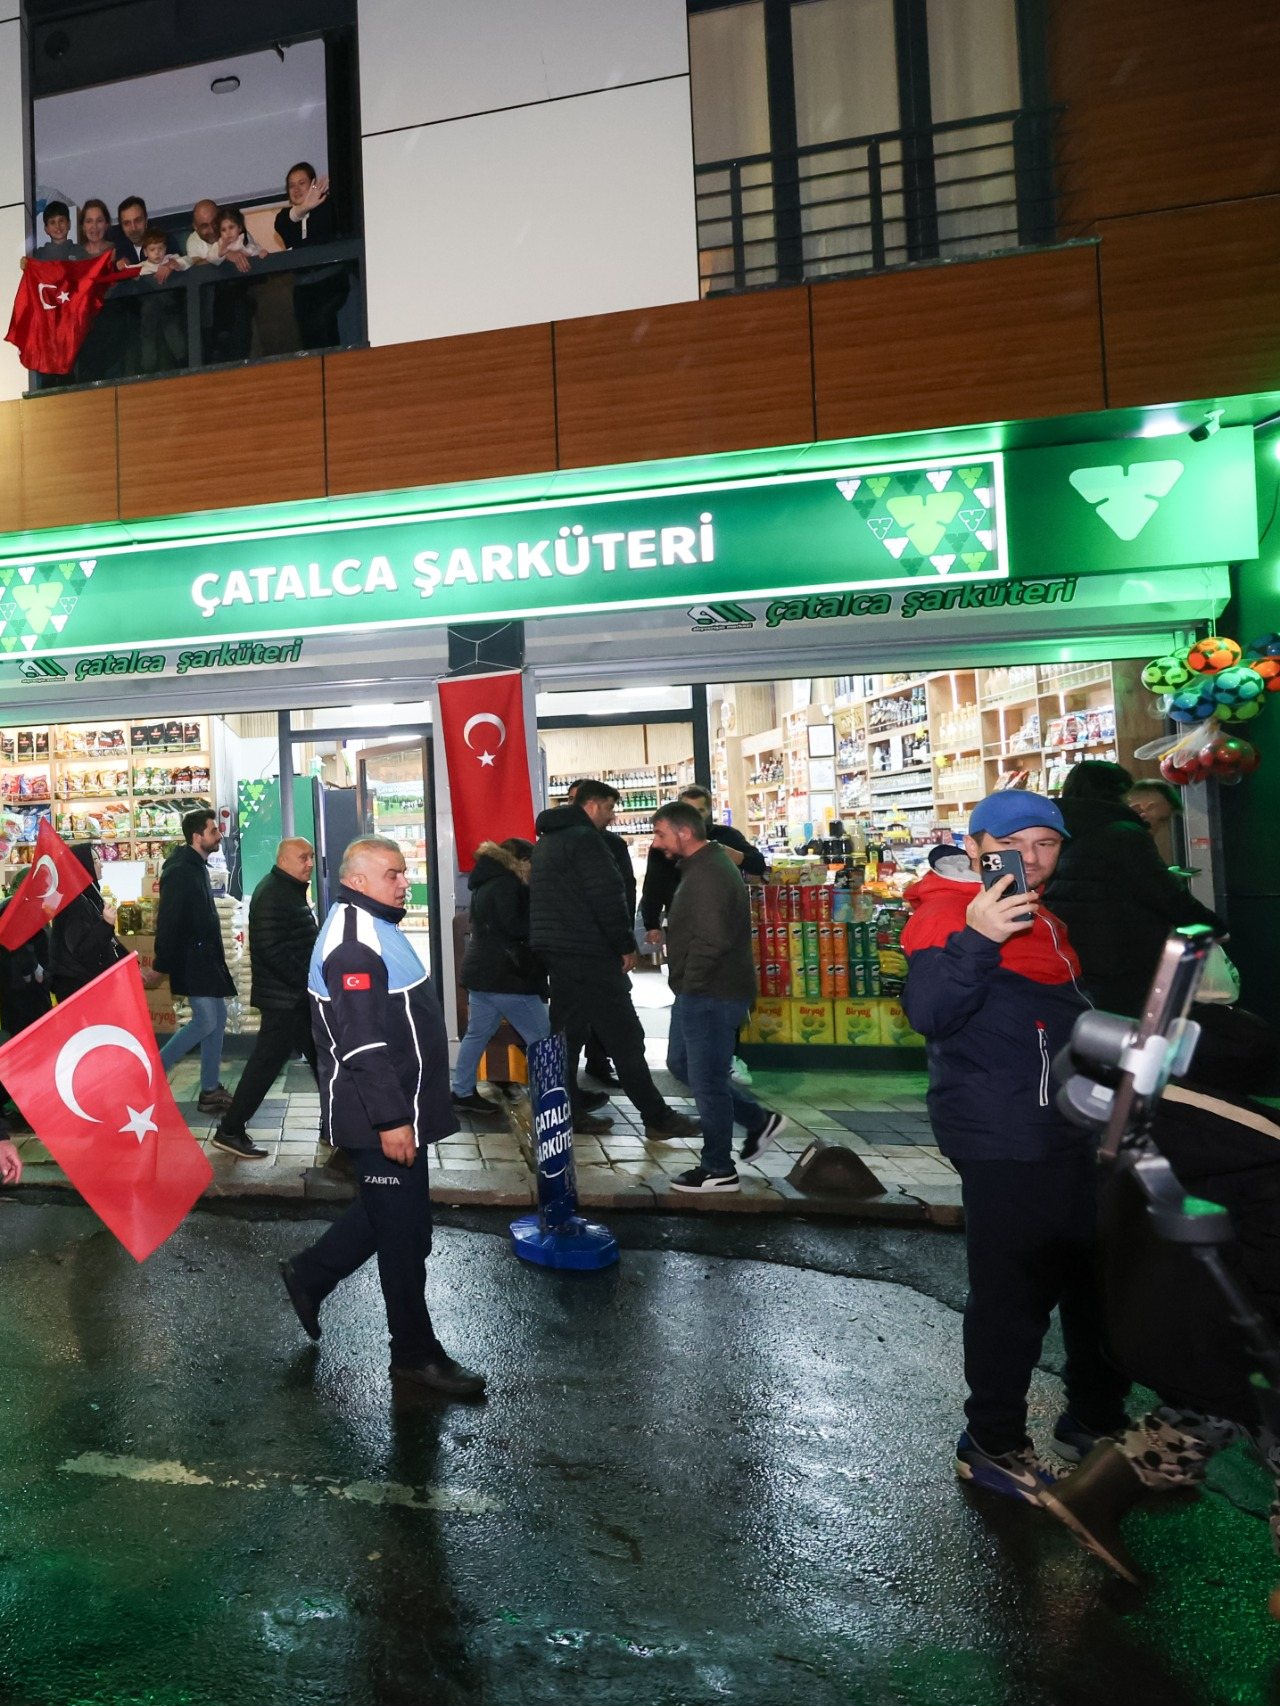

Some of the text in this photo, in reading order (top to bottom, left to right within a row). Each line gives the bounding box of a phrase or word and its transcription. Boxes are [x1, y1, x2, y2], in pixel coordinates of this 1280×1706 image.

[191, 512, 714, 617] ÇATALCA ŞARKÜTERİ
[766, 578, 1078, 627] çatalca şarküteri
[75, 637, 303, 681] çatalca şarküteri
[363, 1175, 401, 1186] ZABITA
